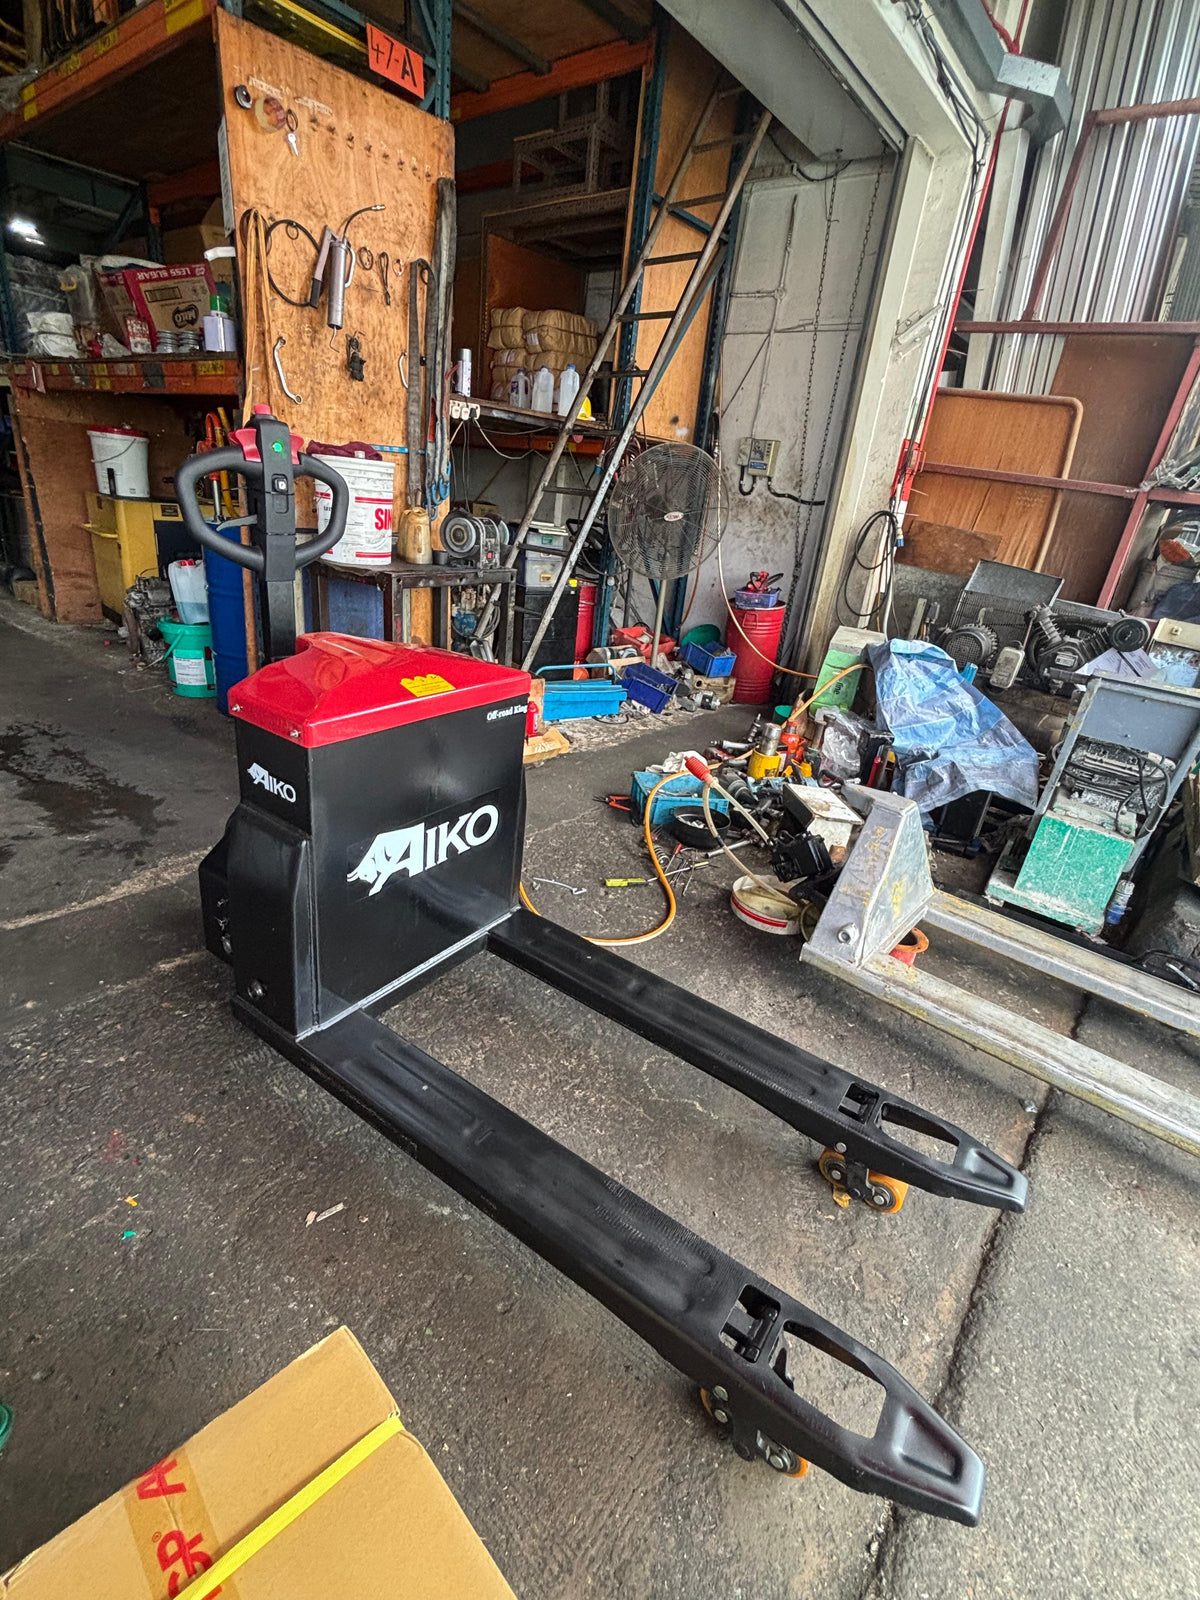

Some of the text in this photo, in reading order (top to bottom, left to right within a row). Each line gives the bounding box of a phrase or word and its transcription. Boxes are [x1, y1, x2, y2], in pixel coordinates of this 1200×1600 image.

[369, 26, 417, 88] 47-A
[136, 267, 191, 280] LESS SUGAR
[174, 308, 197, 323] MILO
[486, 704, 529, 721] Off-road King
[247, 762, 297, 803] AIKO
[347, 804, 499, 897] AIKO
